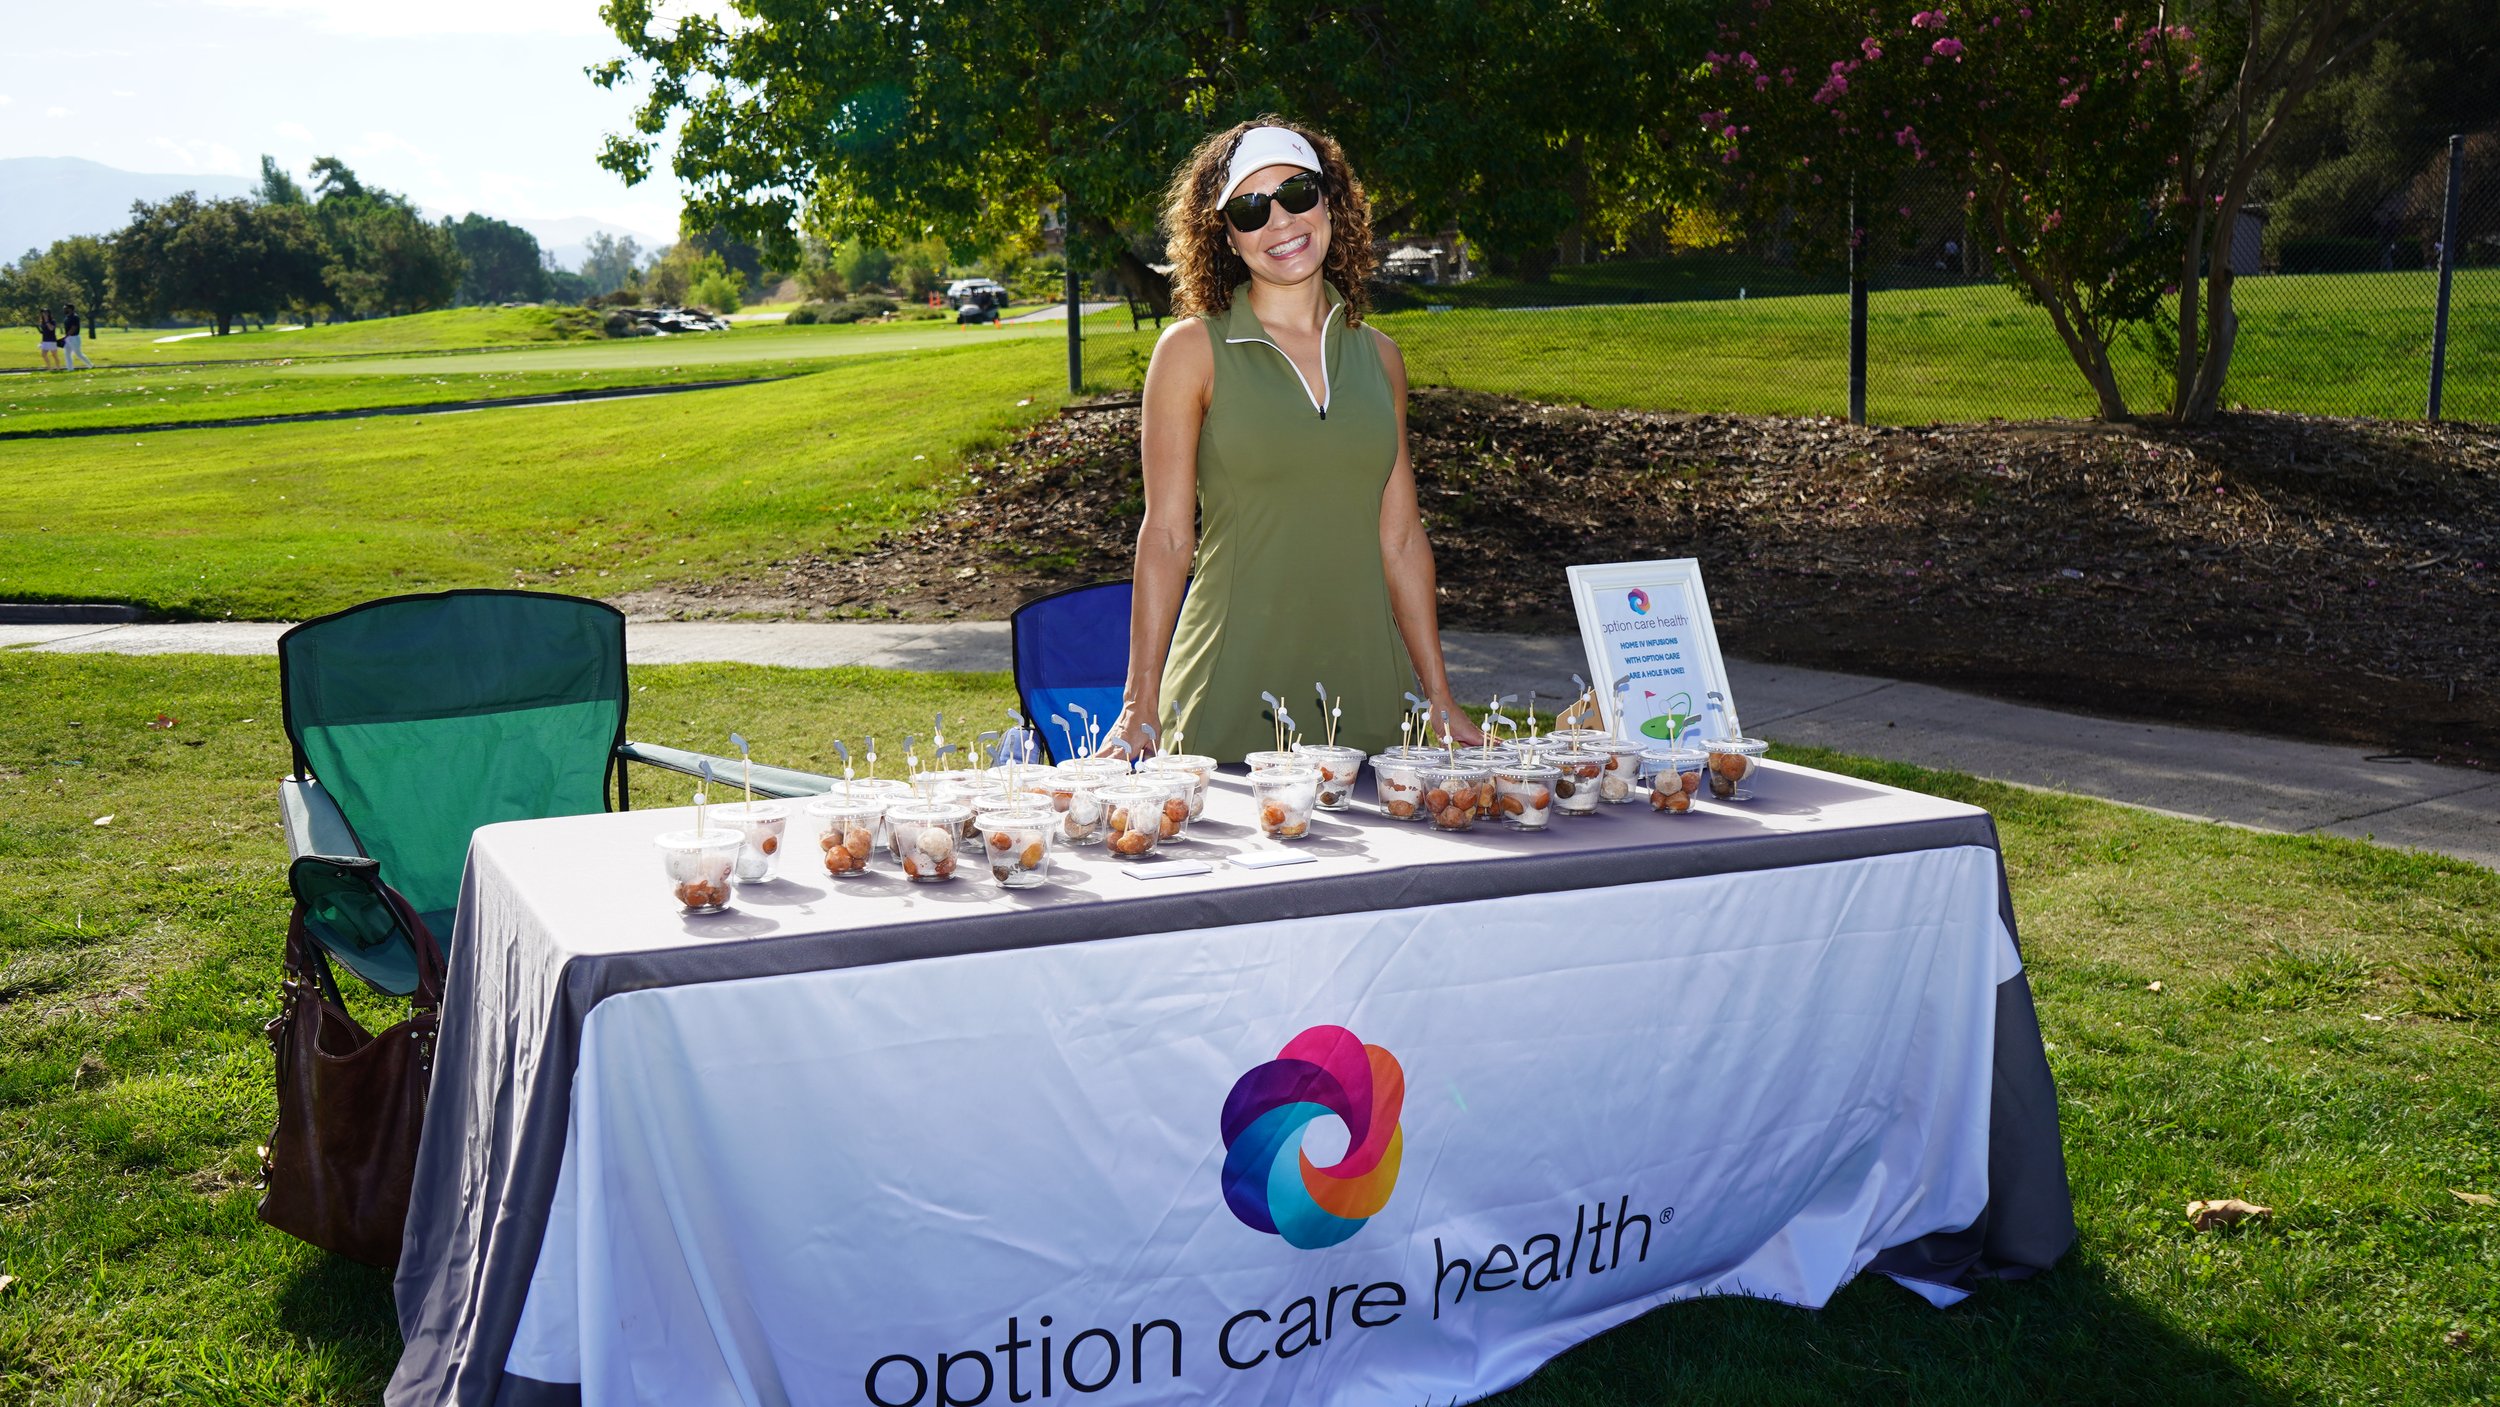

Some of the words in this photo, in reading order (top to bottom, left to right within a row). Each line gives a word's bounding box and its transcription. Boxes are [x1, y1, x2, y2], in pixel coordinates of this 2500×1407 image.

[1634, 619, 1656, 630] care
[1620, 641, 1639, 649] HOME
[1646, 638, 1678, 647] INFUSIONS
[1625, 656, 1641, 664] WITH
[1642, 654, 1664, 662] OPTION
[1665, 652, 1680, 660] CARE
[1629, 671, 1641, 679] ARE
[1646, 669, 1663, 677] HOLE
[864, 1315, 1182, 1407] option
[1218, 1281, 1406, 1371] care
